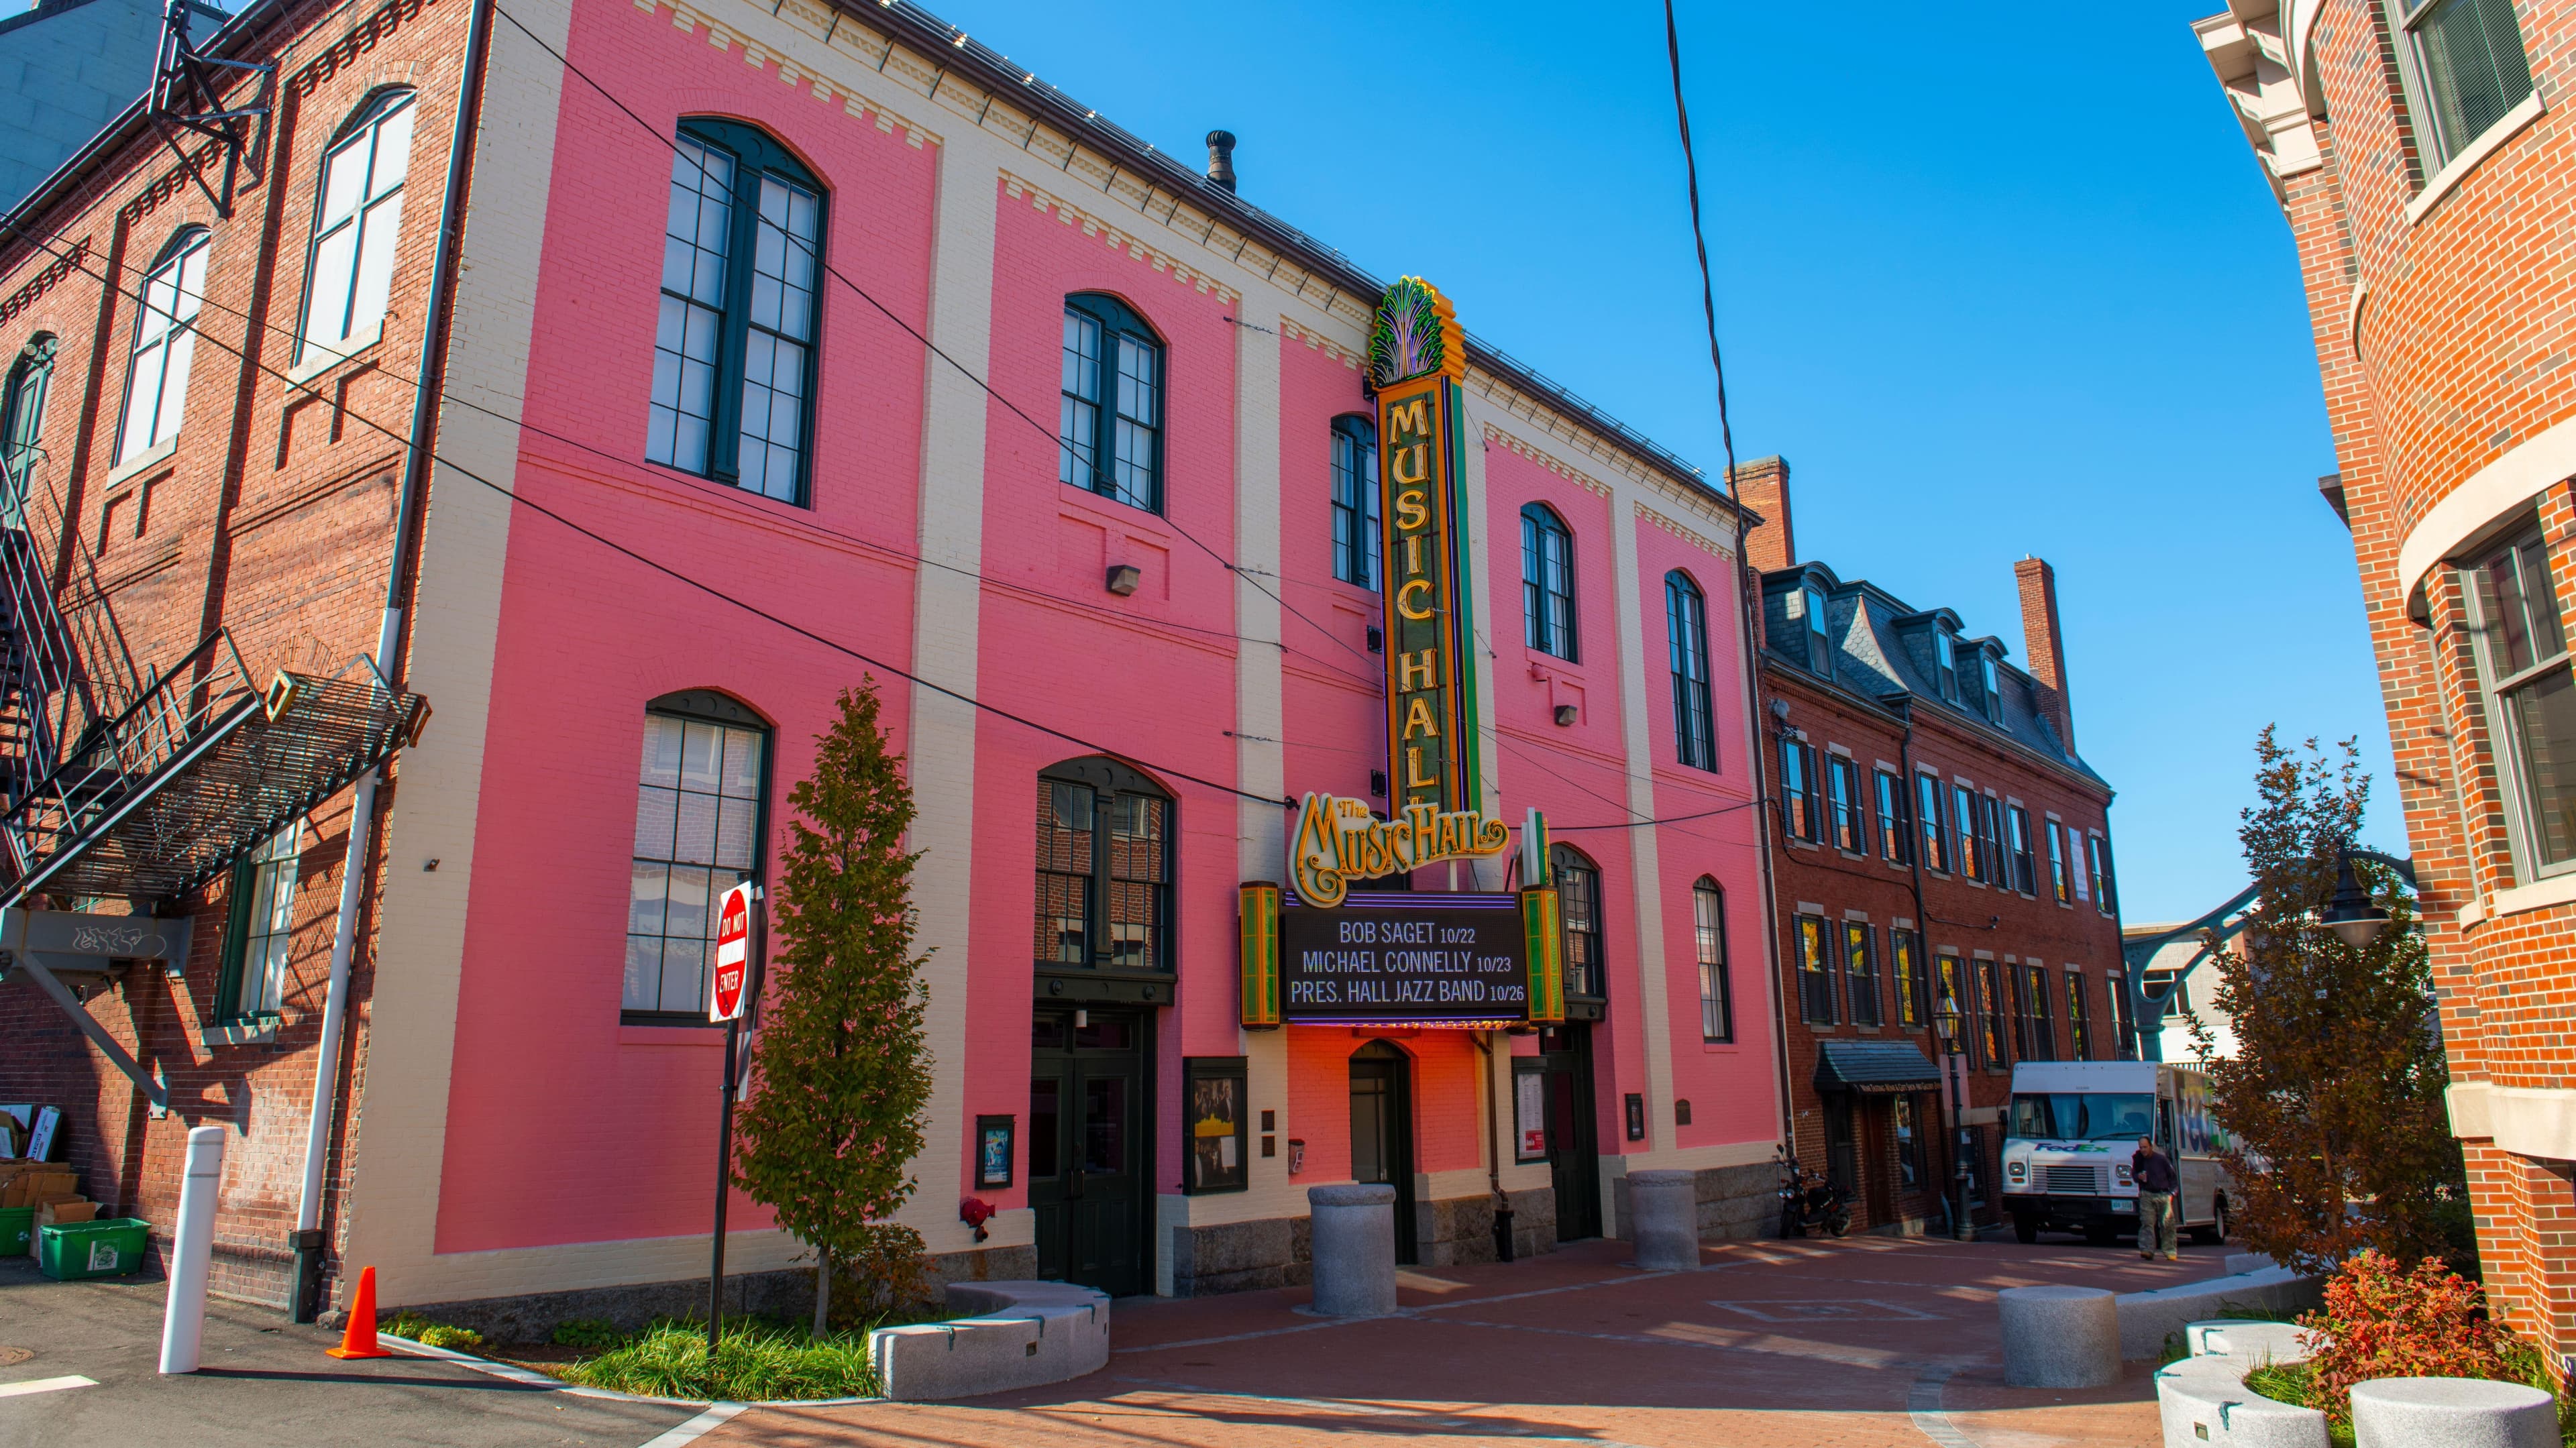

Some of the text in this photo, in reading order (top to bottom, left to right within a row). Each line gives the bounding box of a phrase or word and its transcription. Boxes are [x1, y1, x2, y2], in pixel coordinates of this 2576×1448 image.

[1388, 398, 1441, 805] MUSIC HAL
[1338, 800, 1367, 818] The
[722, 911, 745, 937] DO NOT
[1340, 922, 1476, 944] BOB SAGET 10/22
[1303, 951, 1511, 972] MICHAEL CONNELLY 10/23
[720, 970, 739, 993] ENTER
[1291, 981, 1525, 1003] PRES. HALL JAZZ BAND 10/26
[2035, 1143, 2111, 1153] FedEx
